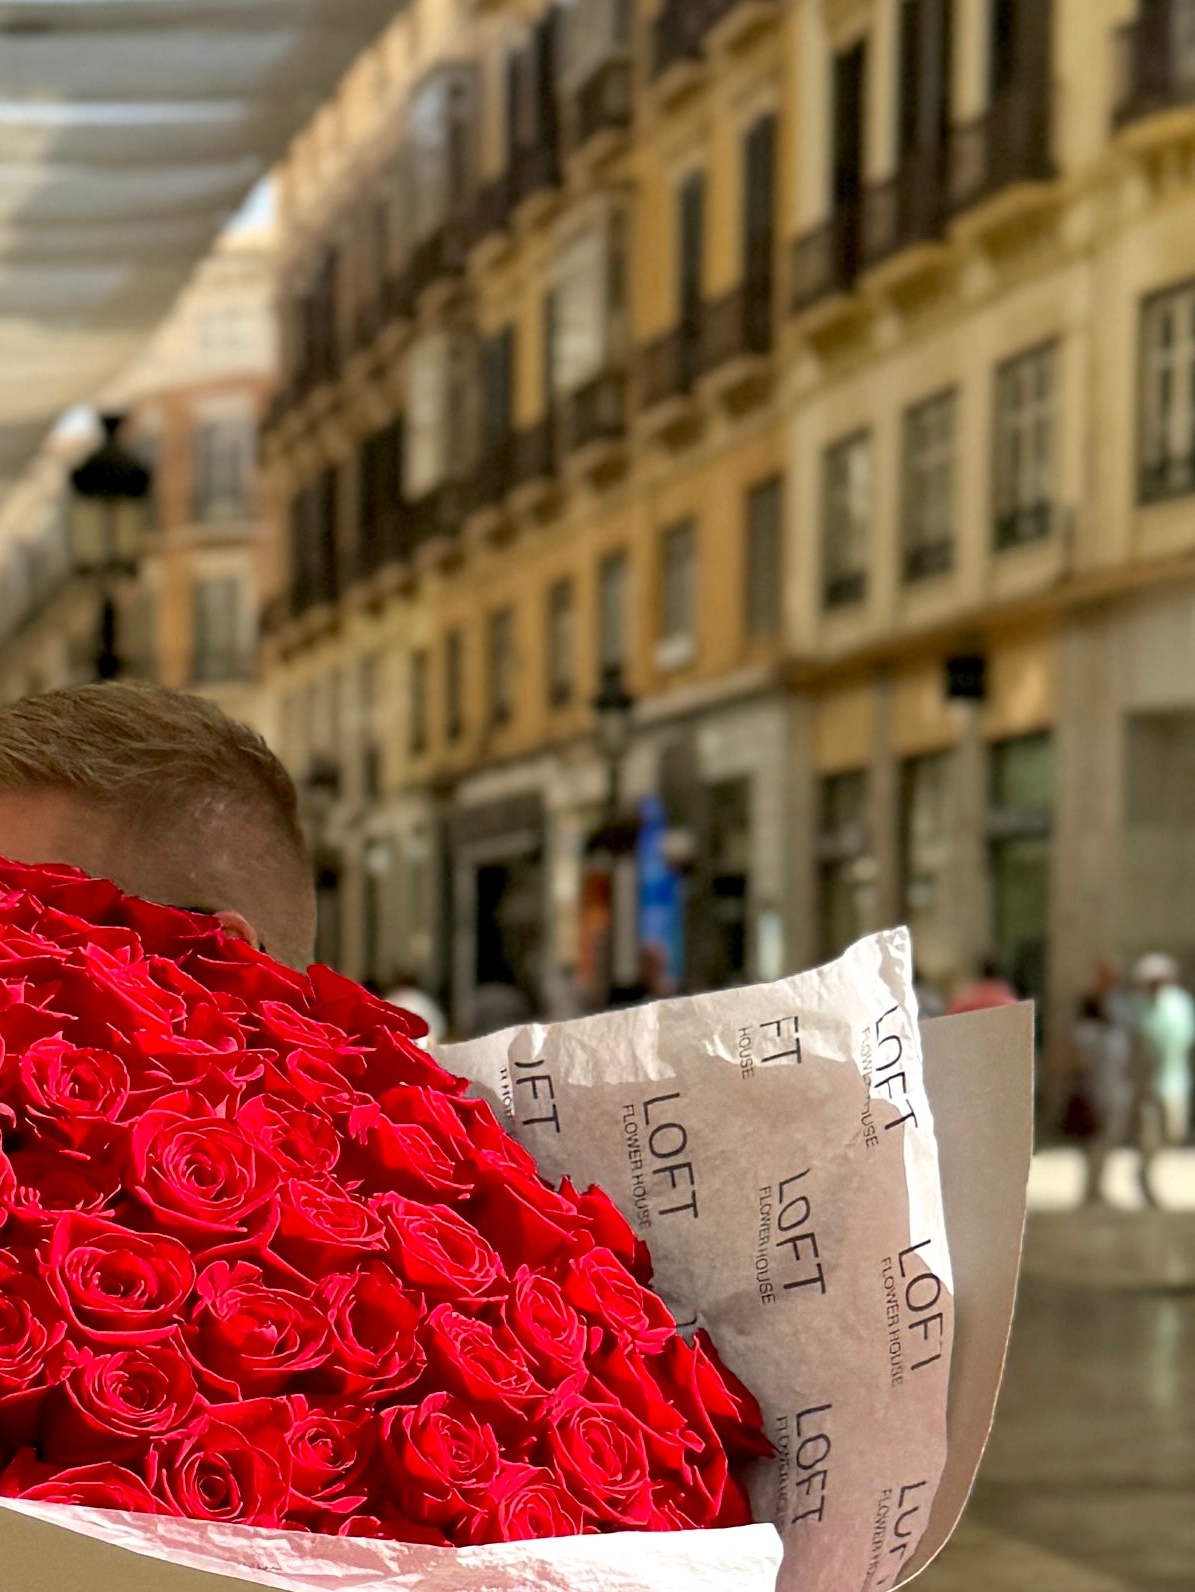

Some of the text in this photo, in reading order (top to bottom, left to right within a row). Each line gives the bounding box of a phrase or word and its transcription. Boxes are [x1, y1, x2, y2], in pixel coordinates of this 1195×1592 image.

[514, 1059, 561, 1134] FT
[738, 1026, 755, 1081] HOUSE
[759, 1016, 802, 1064] FT
[622, 1103, 652, 1229] FLOWER HOUSE
[642, 1092, 699, 1219] LOFT
[755, 1185, 776, 1305] FLOWER HOUSE
[775, 1168, 826, 1295] LOFT
[880, 1256, 904, 1388] FLOWER HOUSE
[792, 1403, 833, 1525] LOFT
